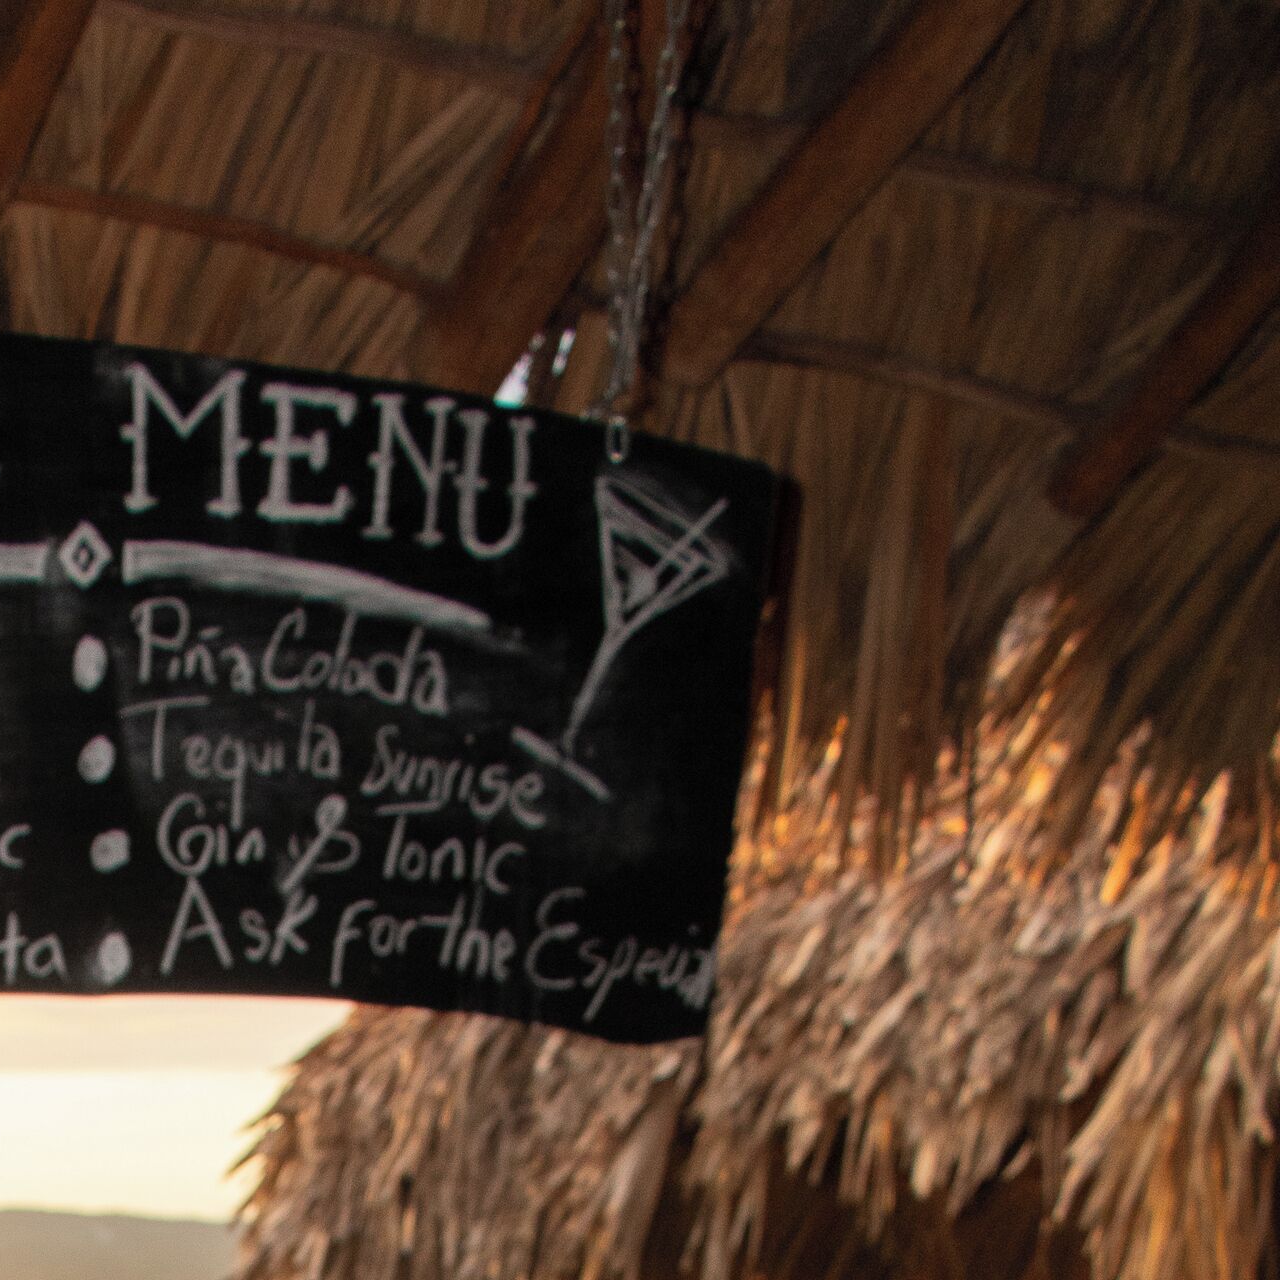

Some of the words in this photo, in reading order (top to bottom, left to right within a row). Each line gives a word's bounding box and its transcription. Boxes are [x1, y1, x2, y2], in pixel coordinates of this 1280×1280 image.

[120, 363, 537, 558] MENU
[121, 696, 341, 829] Tequila
[360, 723, 547, 829] Sunrise
[156, 792, 267, 876] Gin
[375, 800, 527, 895] Tonic
[160, 876, 318, 976] Ask
